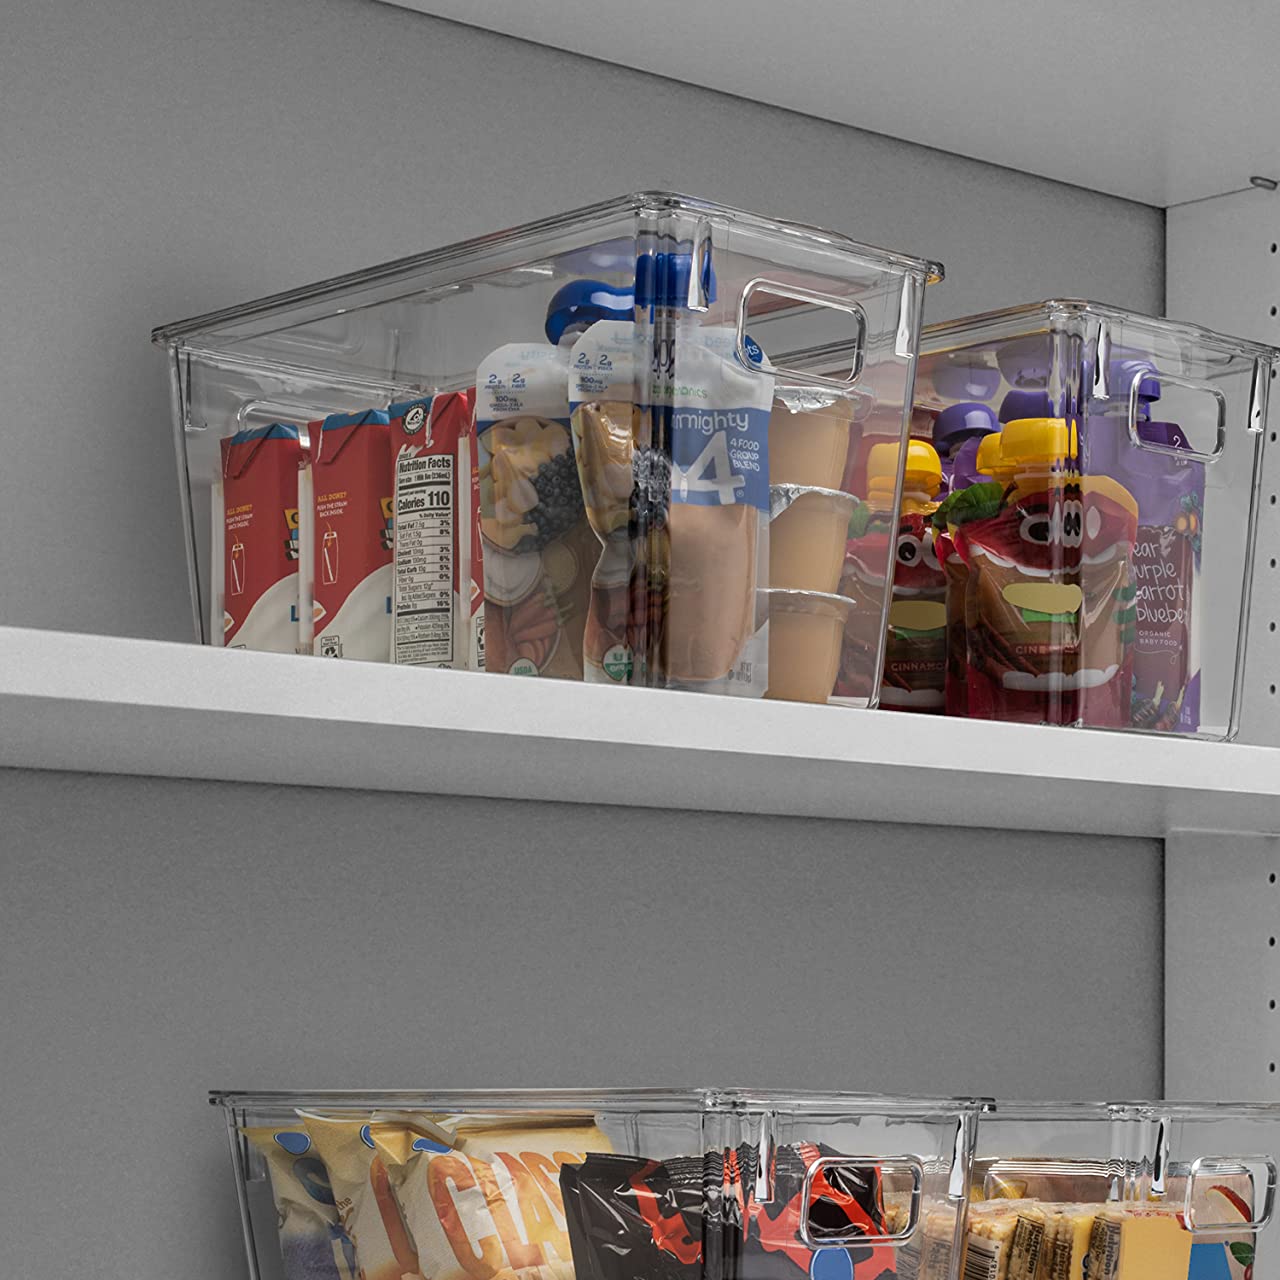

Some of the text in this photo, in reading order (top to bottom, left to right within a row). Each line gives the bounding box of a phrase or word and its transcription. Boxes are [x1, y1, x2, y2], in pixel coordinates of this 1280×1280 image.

[738, 438, 760, 451] FOOD
[729, 449, 760, 461] GROUP
[428, 457, 451, 469] Facts
[732, 459, 760, 472] BLEND
[398, 497, 425, 512] Calories
[428, 490, 450, 506] 110
[1136, 602, 1187, 624] bluebe
[1138, 630, 1171, 638] ORGANIC
[1027, 1223, 1044, 1274] Nutrition
[1104, 1224, 1120, 1275] Nutrition
